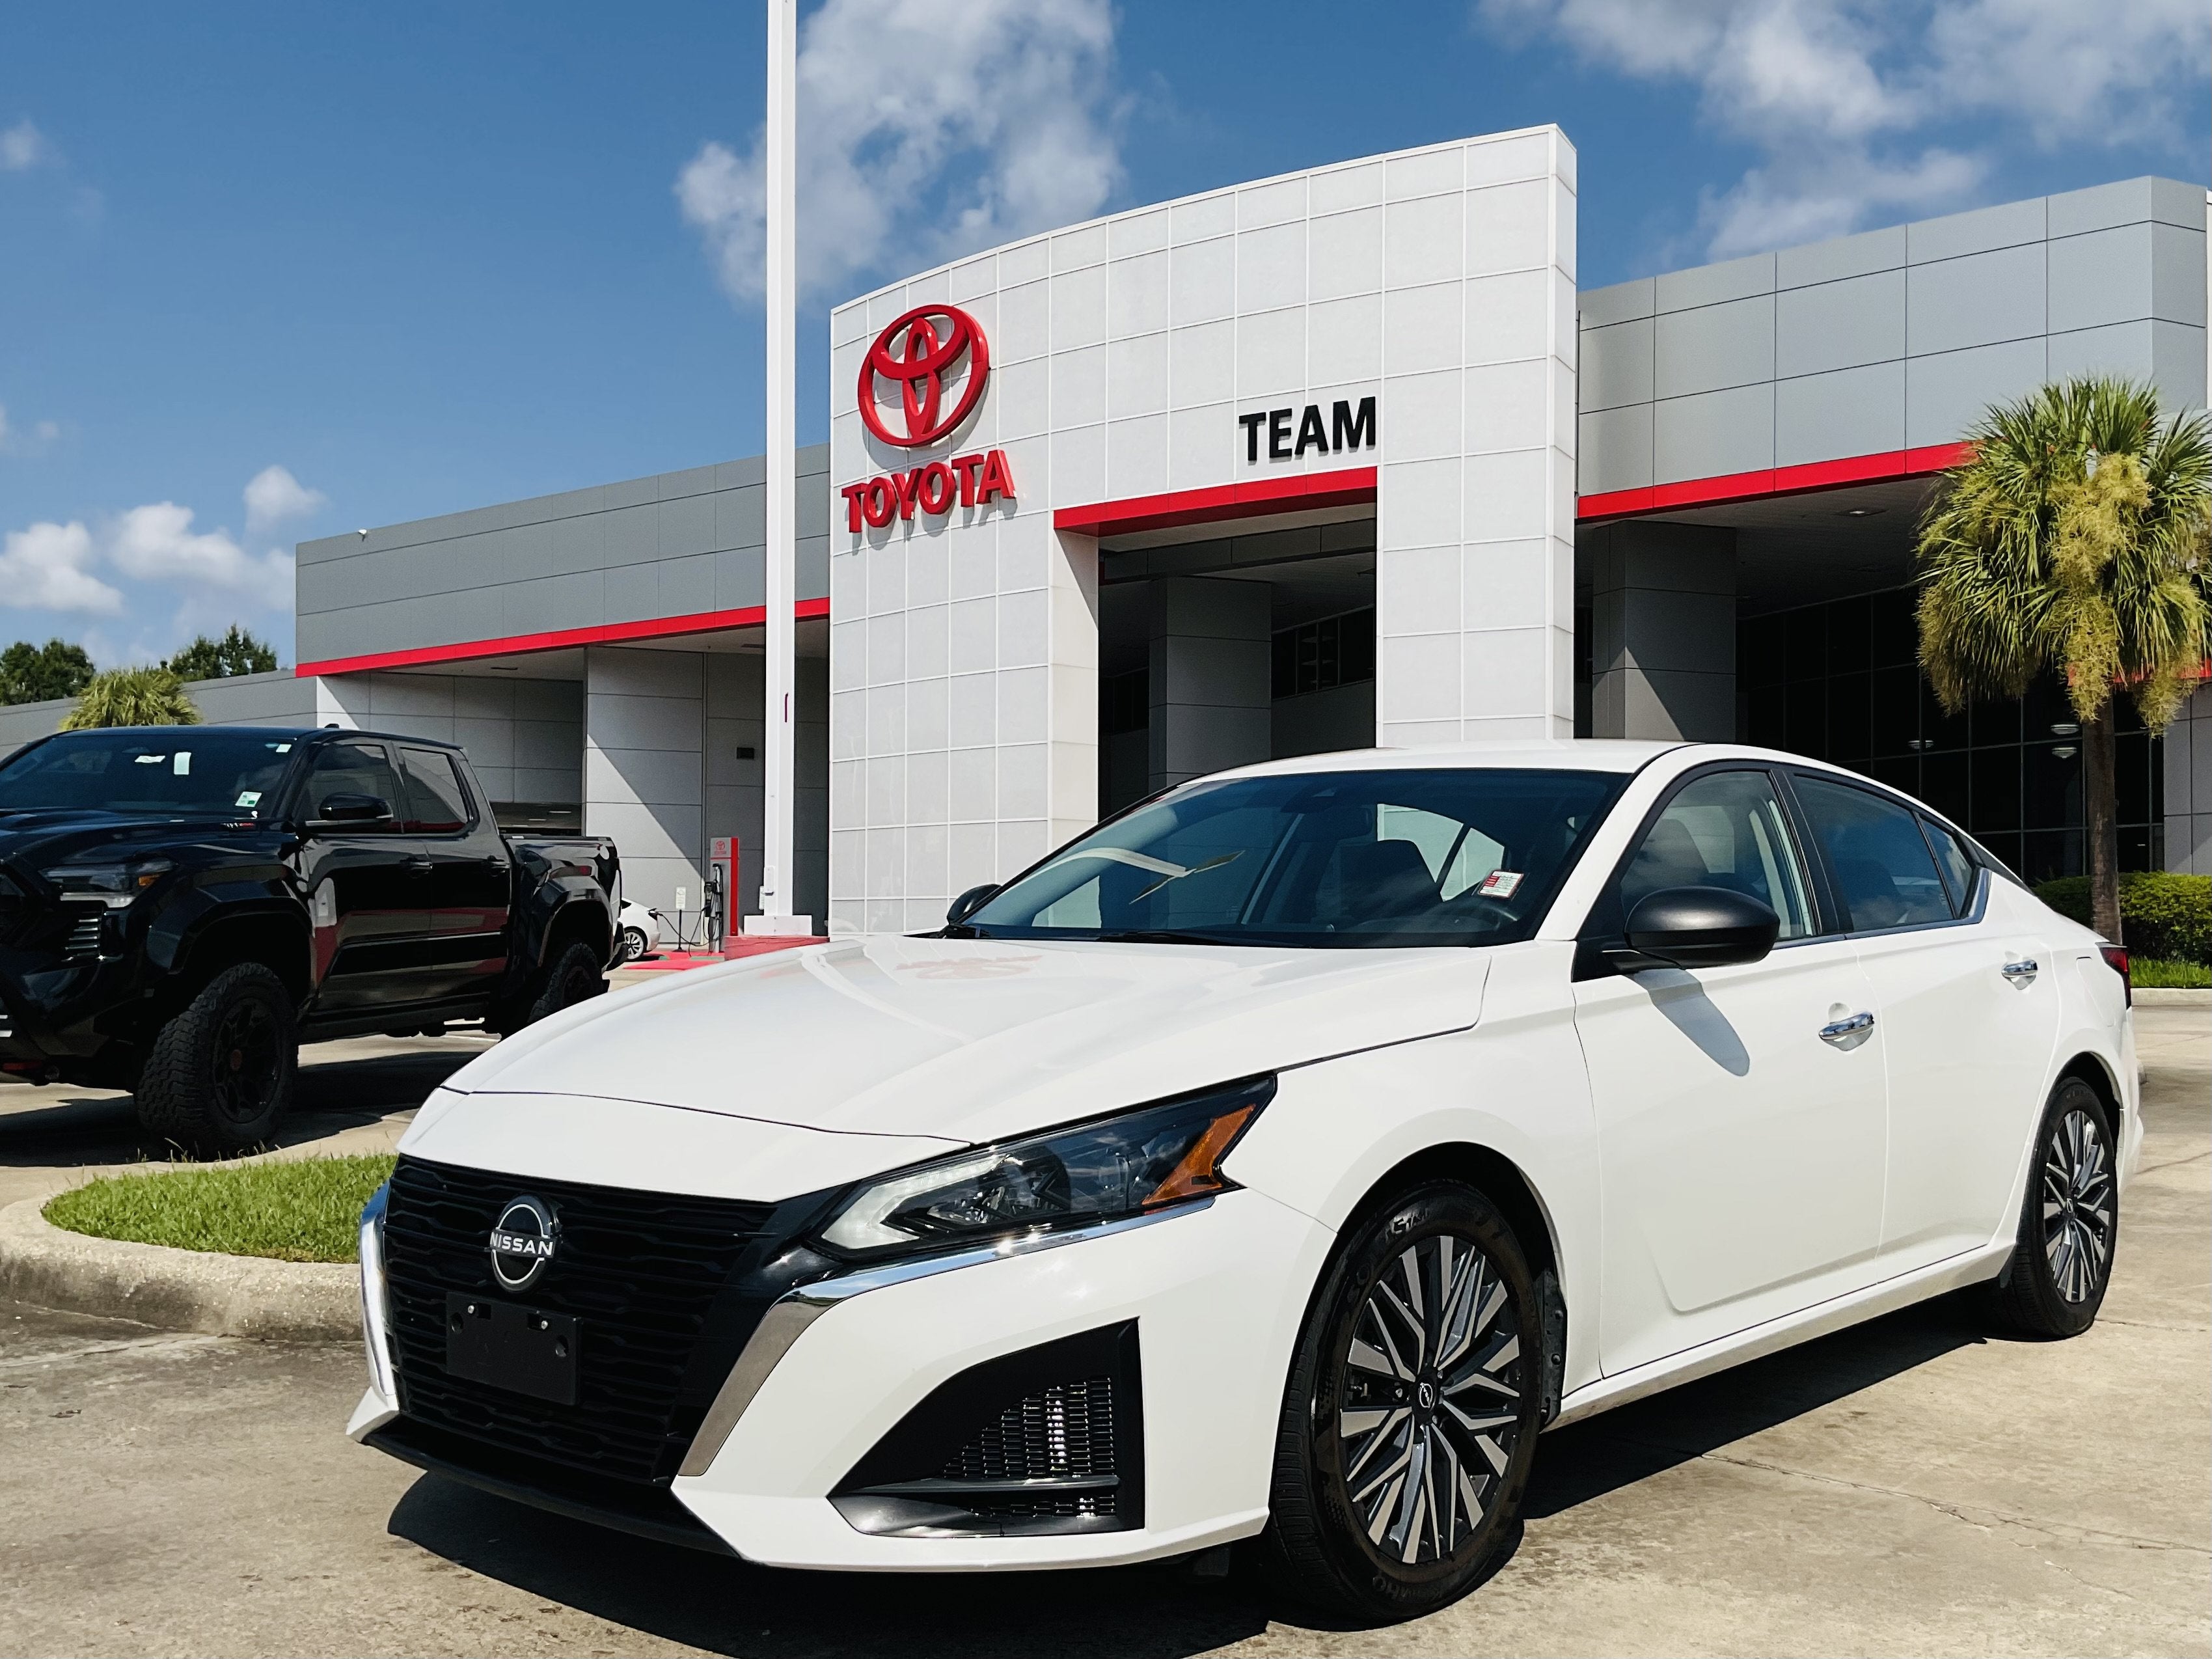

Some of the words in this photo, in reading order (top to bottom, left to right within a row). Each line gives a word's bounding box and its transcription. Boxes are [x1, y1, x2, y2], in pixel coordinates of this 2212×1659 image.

[1239, 396, 1376, 461] TEAM
[841, 449, 1016, 533] TOYOTA
[490, 1231, 553, 1255] NISSAN
